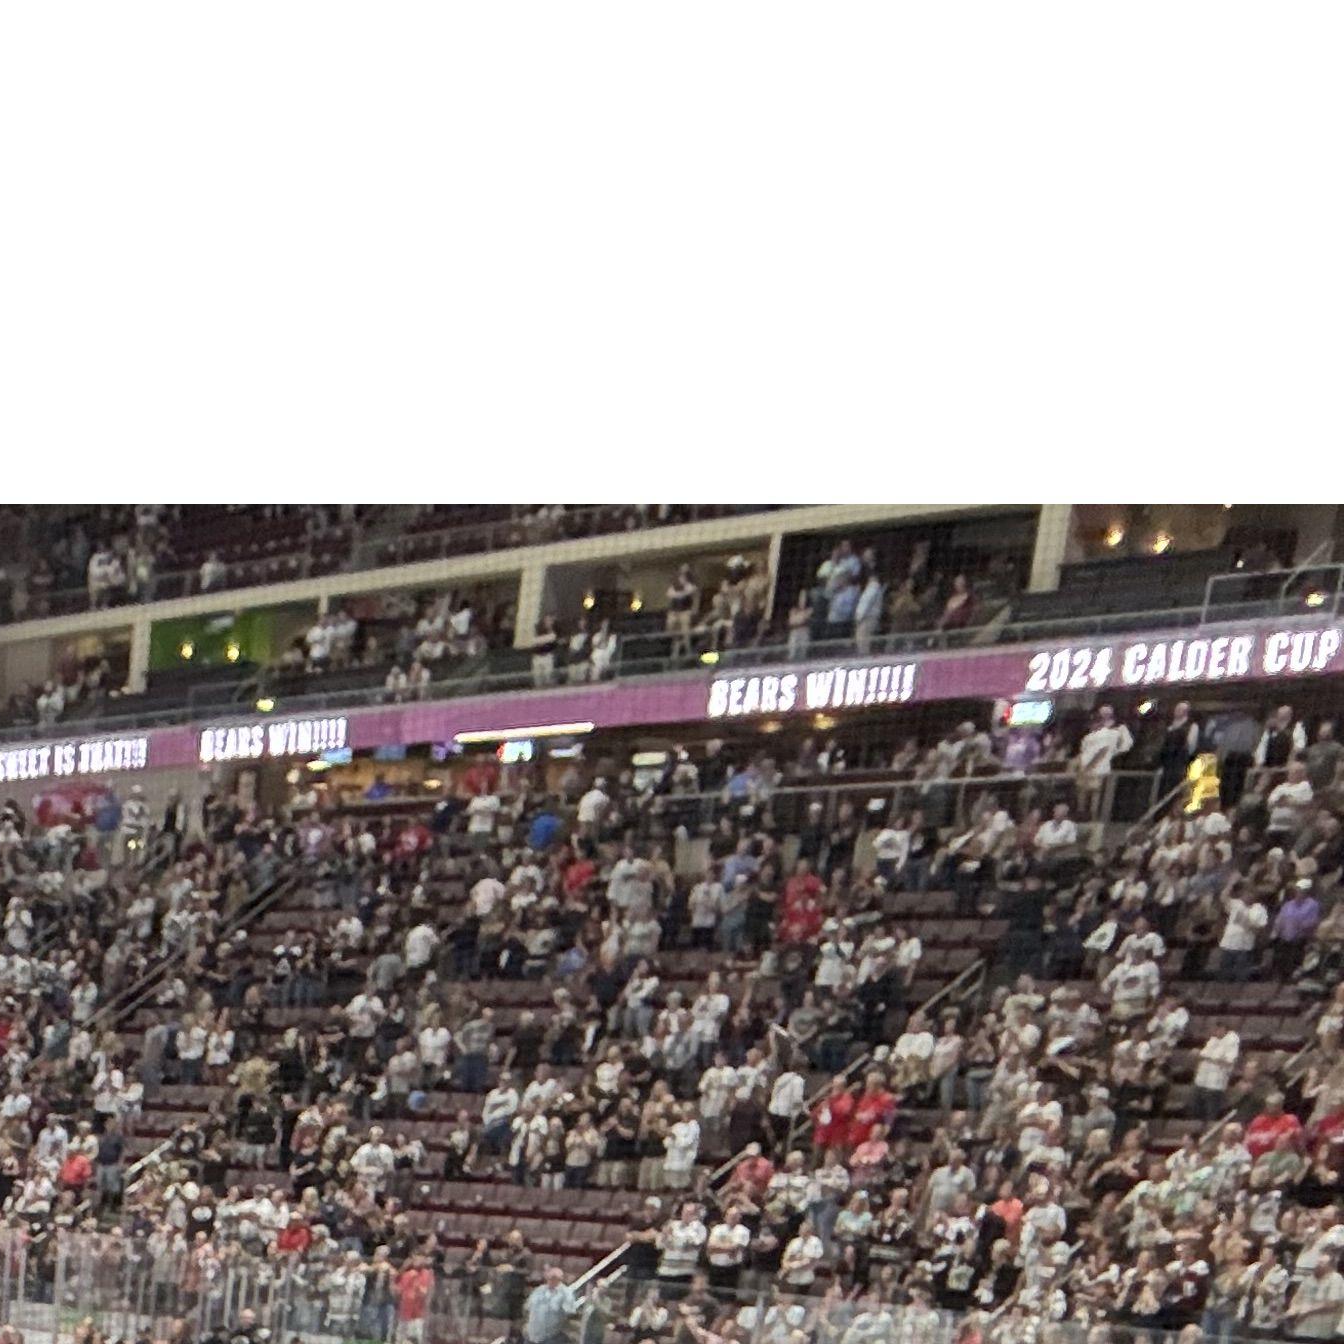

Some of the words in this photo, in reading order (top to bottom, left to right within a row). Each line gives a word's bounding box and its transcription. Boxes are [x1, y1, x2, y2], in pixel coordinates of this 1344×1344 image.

[1025, 647, 1113, 691] 2024
[1123, 635, 1254, 685] CALDER
[1262, 628, 1342, 675] CUP
[708, 673, 799, 718] BEARS
[199, 724, 264, 762] BEARS
